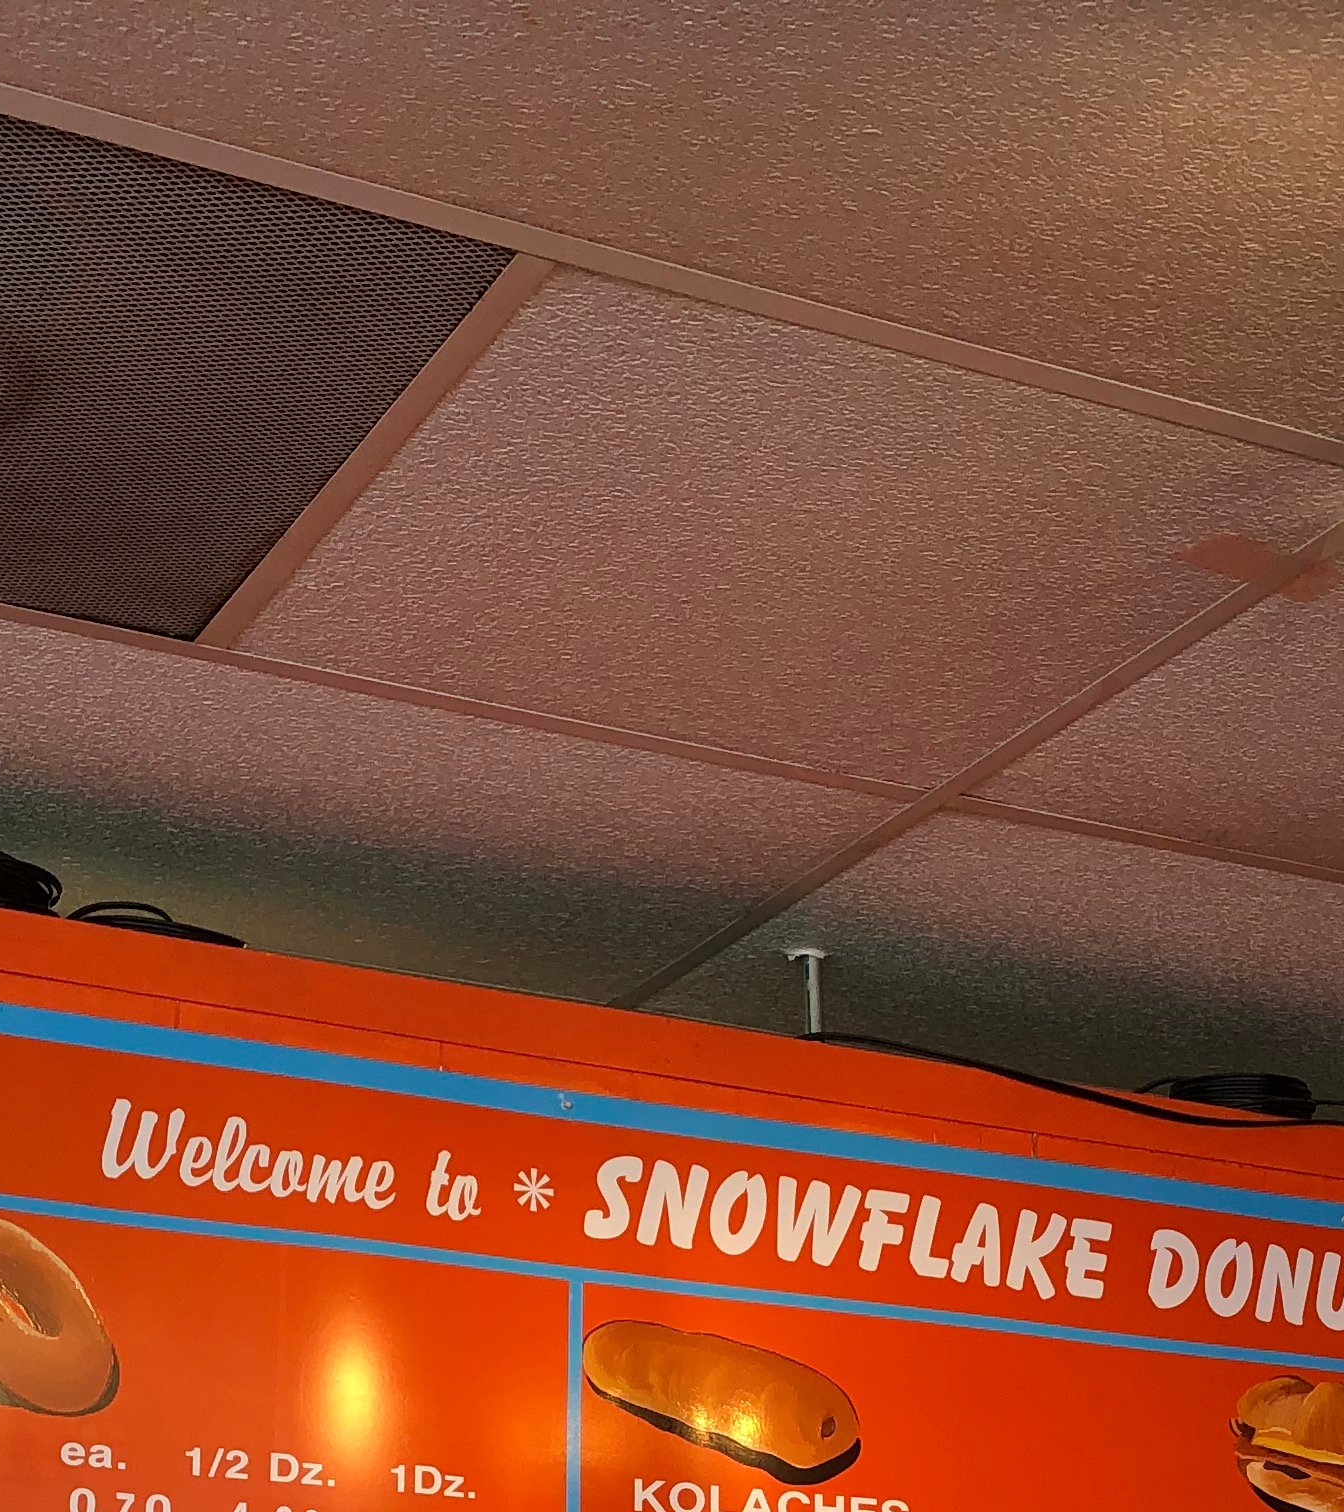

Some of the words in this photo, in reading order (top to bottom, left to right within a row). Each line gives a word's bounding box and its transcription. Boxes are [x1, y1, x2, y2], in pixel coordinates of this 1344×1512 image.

[102, 1099, 394, 1209] Welcome
[427, 1151, 480, 1220] to
[585, 1157, 1112, 1301] SNOWFLAKE
[61, 1443, 125, 1469] ea.
[186, 1448, 248, 1479] 1/2
[270, 1453, 334, 1486] Dz.
[392, 1465, 475, 1498] 1Dz.
